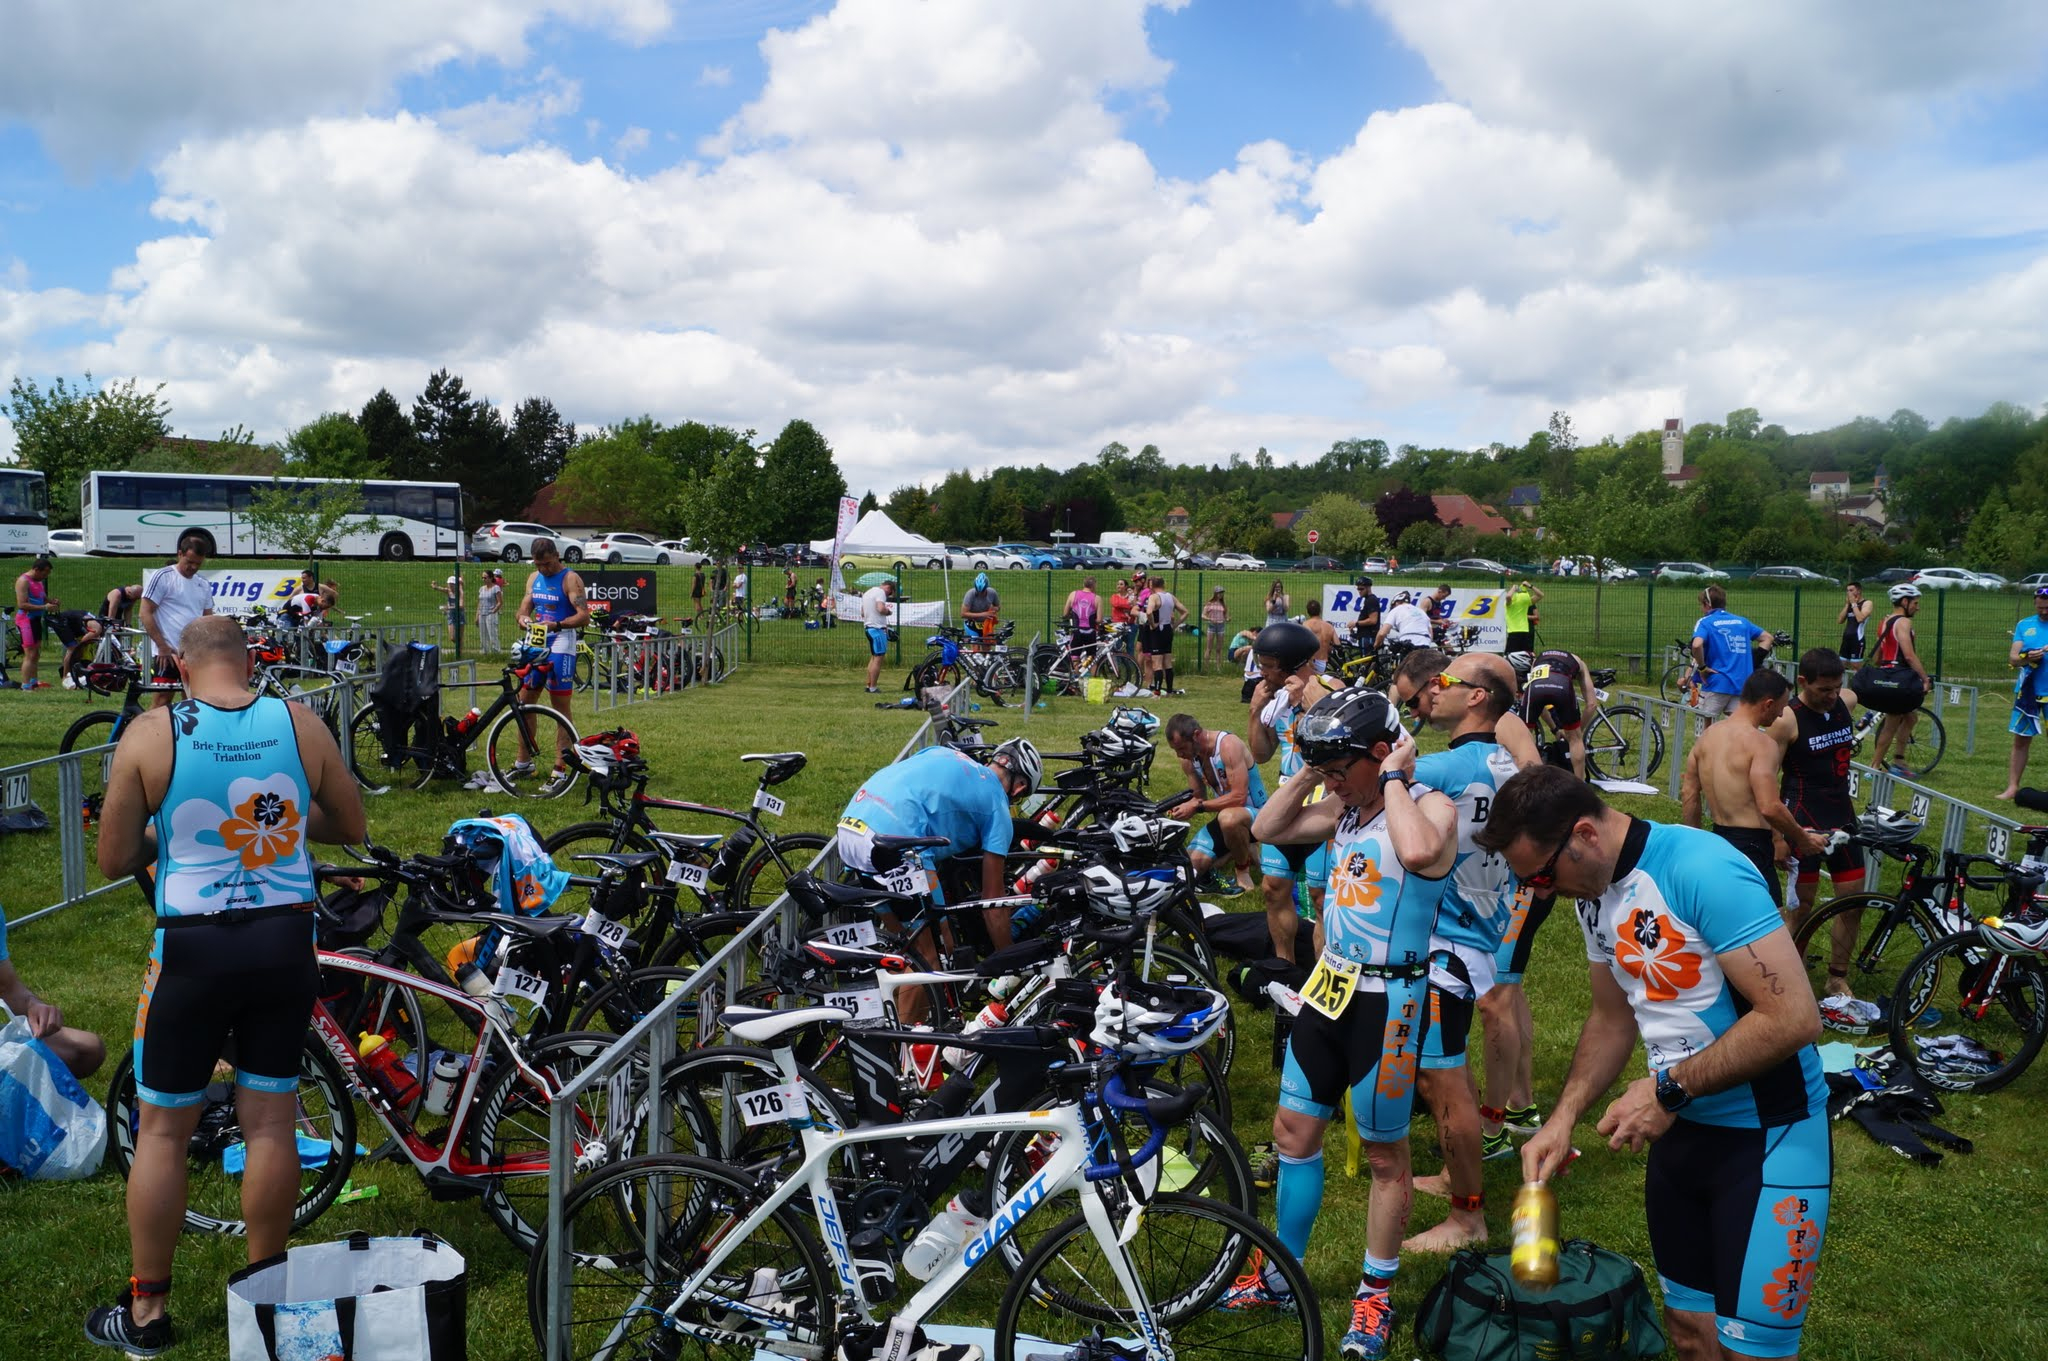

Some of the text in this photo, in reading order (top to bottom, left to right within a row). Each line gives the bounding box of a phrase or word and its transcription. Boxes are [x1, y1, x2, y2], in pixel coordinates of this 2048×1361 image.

[8, 528, 28, 538] Rta
[209, 575, 296, 602] ning 3
[584, 583, 639, 600] risens
[1468, 597, 1493, 616] 3
[531, 628, 546, 646] 65
[193, 737, 279, 752] Brie Francilienne
[1809, 725, 1852, 745] EPERNAY
[1810, 735, 1853, 751] TRIATHLON
[213, 751, 262, 763] Triathlon
[7, 775, 28, 807] 170
[765, 796, 782, 811] 131
[1912, 794, 1929, 819] 84
[1989, 826, 2008, 857] 83
[680, 866, 702, 883] 129
[890, 877, 914, 893] 123
[982, 896, 1048, 909] TREK
[598, 918, 624, 942] 128
[832, 927, 858, 946] 124
[1347, 964, 1356, 974] 3
[1987, 954, 2008, 996] LOO
[514, 974, 542, 995] 127
[1008, 974, 1048, 1014] TRE
[830, 996, 859, 1018] 125
[247, 1077, 278, 1088] poli
[609, 1066, 630, 1137] 126
[744, 1091, 784, 1118] 126
[963, 1172, 1048, 1269] GIANT
[817, 1195, 855, 1286] DEFY
[694, 1326, 776, 1350] GIANT
[1138, 1311, 1160, 1351] GIANT
